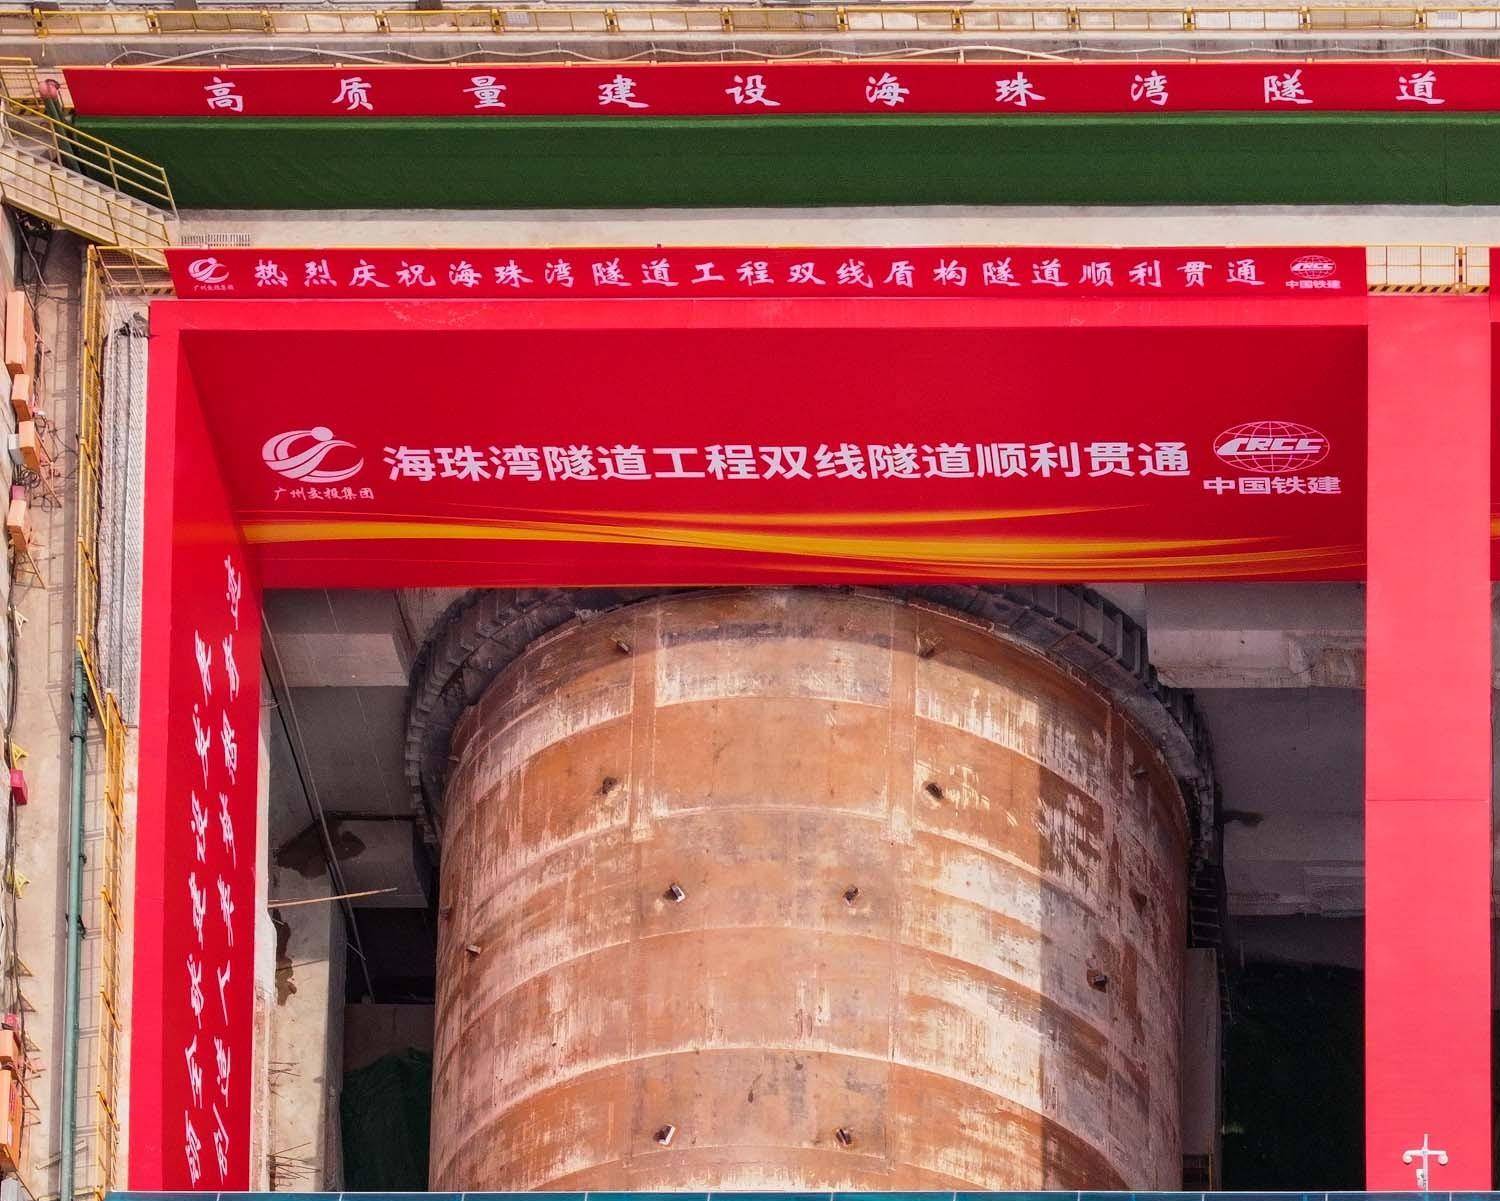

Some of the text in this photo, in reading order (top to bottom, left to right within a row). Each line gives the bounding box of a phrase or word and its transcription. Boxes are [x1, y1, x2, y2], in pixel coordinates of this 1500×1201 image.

[254, 257, 1265, 288] 热烈庆祝海珠湾隧道工程双线盾构隧道顺利贯通
[1285, 280, 1341, 289] 中国铁建
[383, 441, 1191, 482] 海珠湾隧道工程双线隧道顺利贯通
[1203, 476, 1342, 495] 中国铁建
